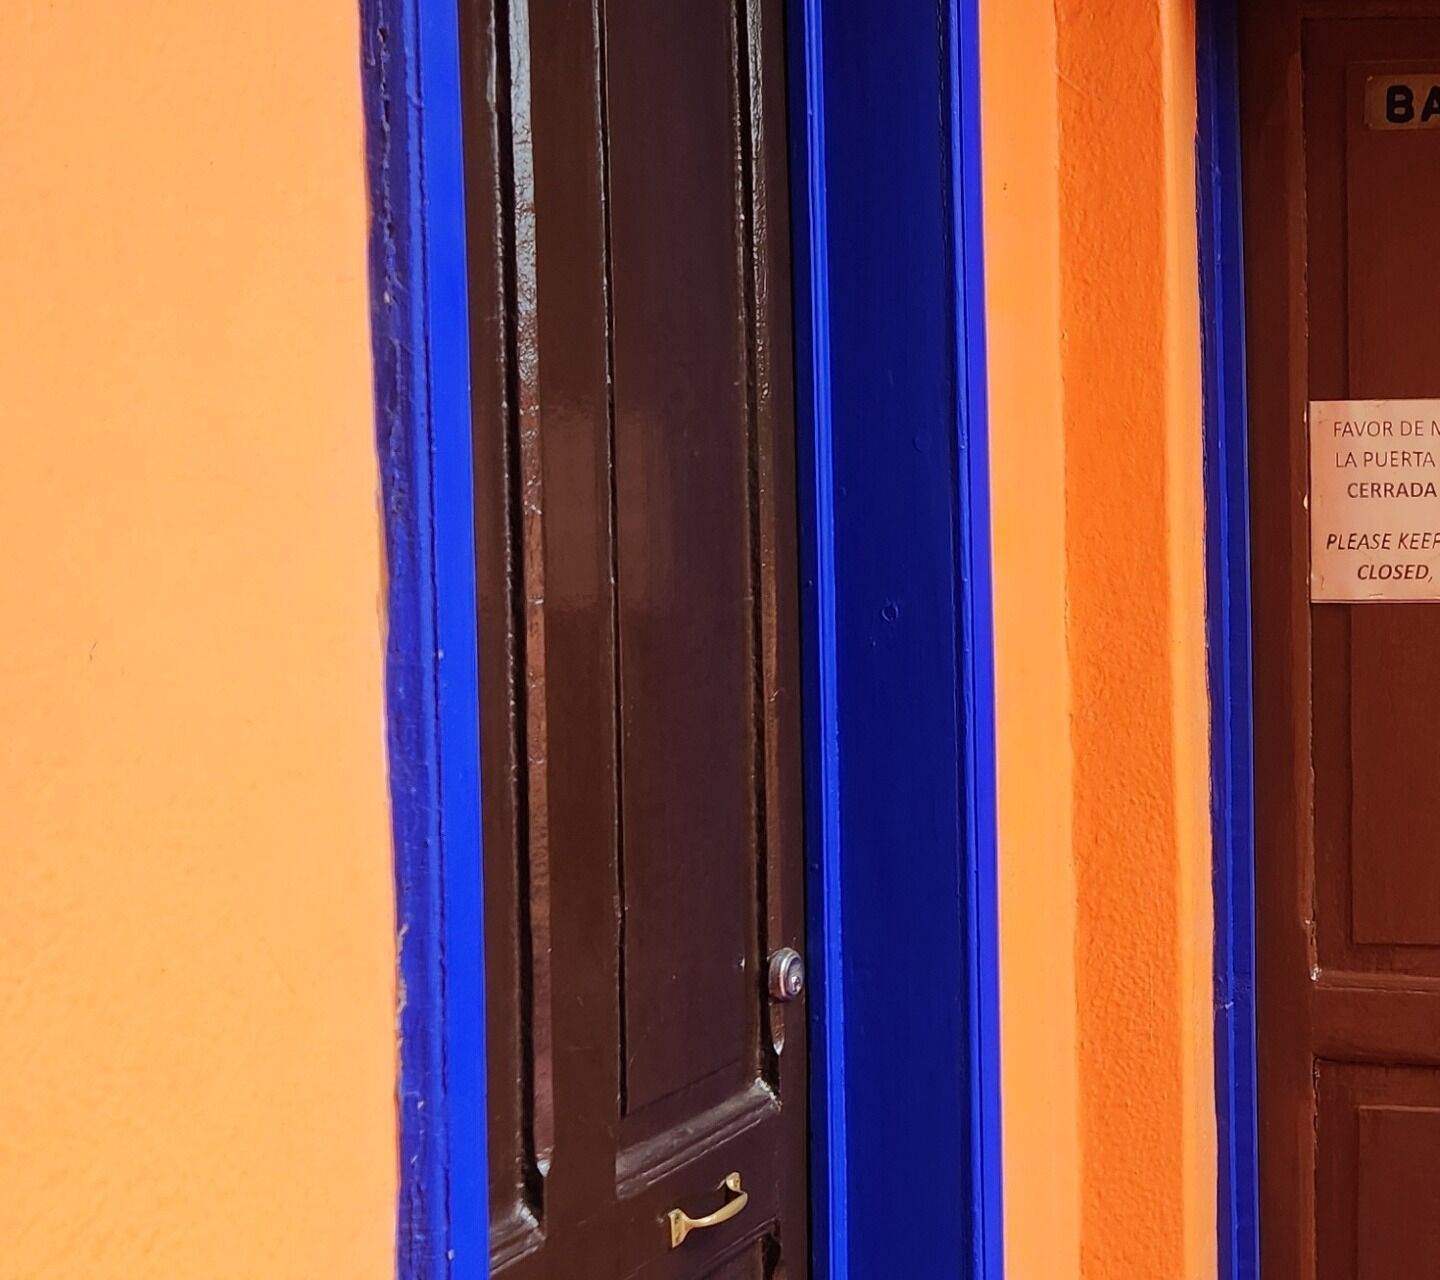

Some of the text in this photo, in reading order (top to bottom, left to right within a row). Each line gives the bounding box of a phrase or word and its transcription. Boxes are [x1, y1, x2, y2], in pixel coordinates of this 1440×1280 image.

[1333, 421, 1393, 437] FAVOR
[1400, 421, 1424, 436] DE
[1335, 451, 1357, 468] LA
[1363, 451, 1436, 467] PUERTA
[1347, 482, 1438, 498] CERRADA
[1326, 533, 1392, 550] PLEASE
[1357, 564, 1433, 583] CLOSED,
